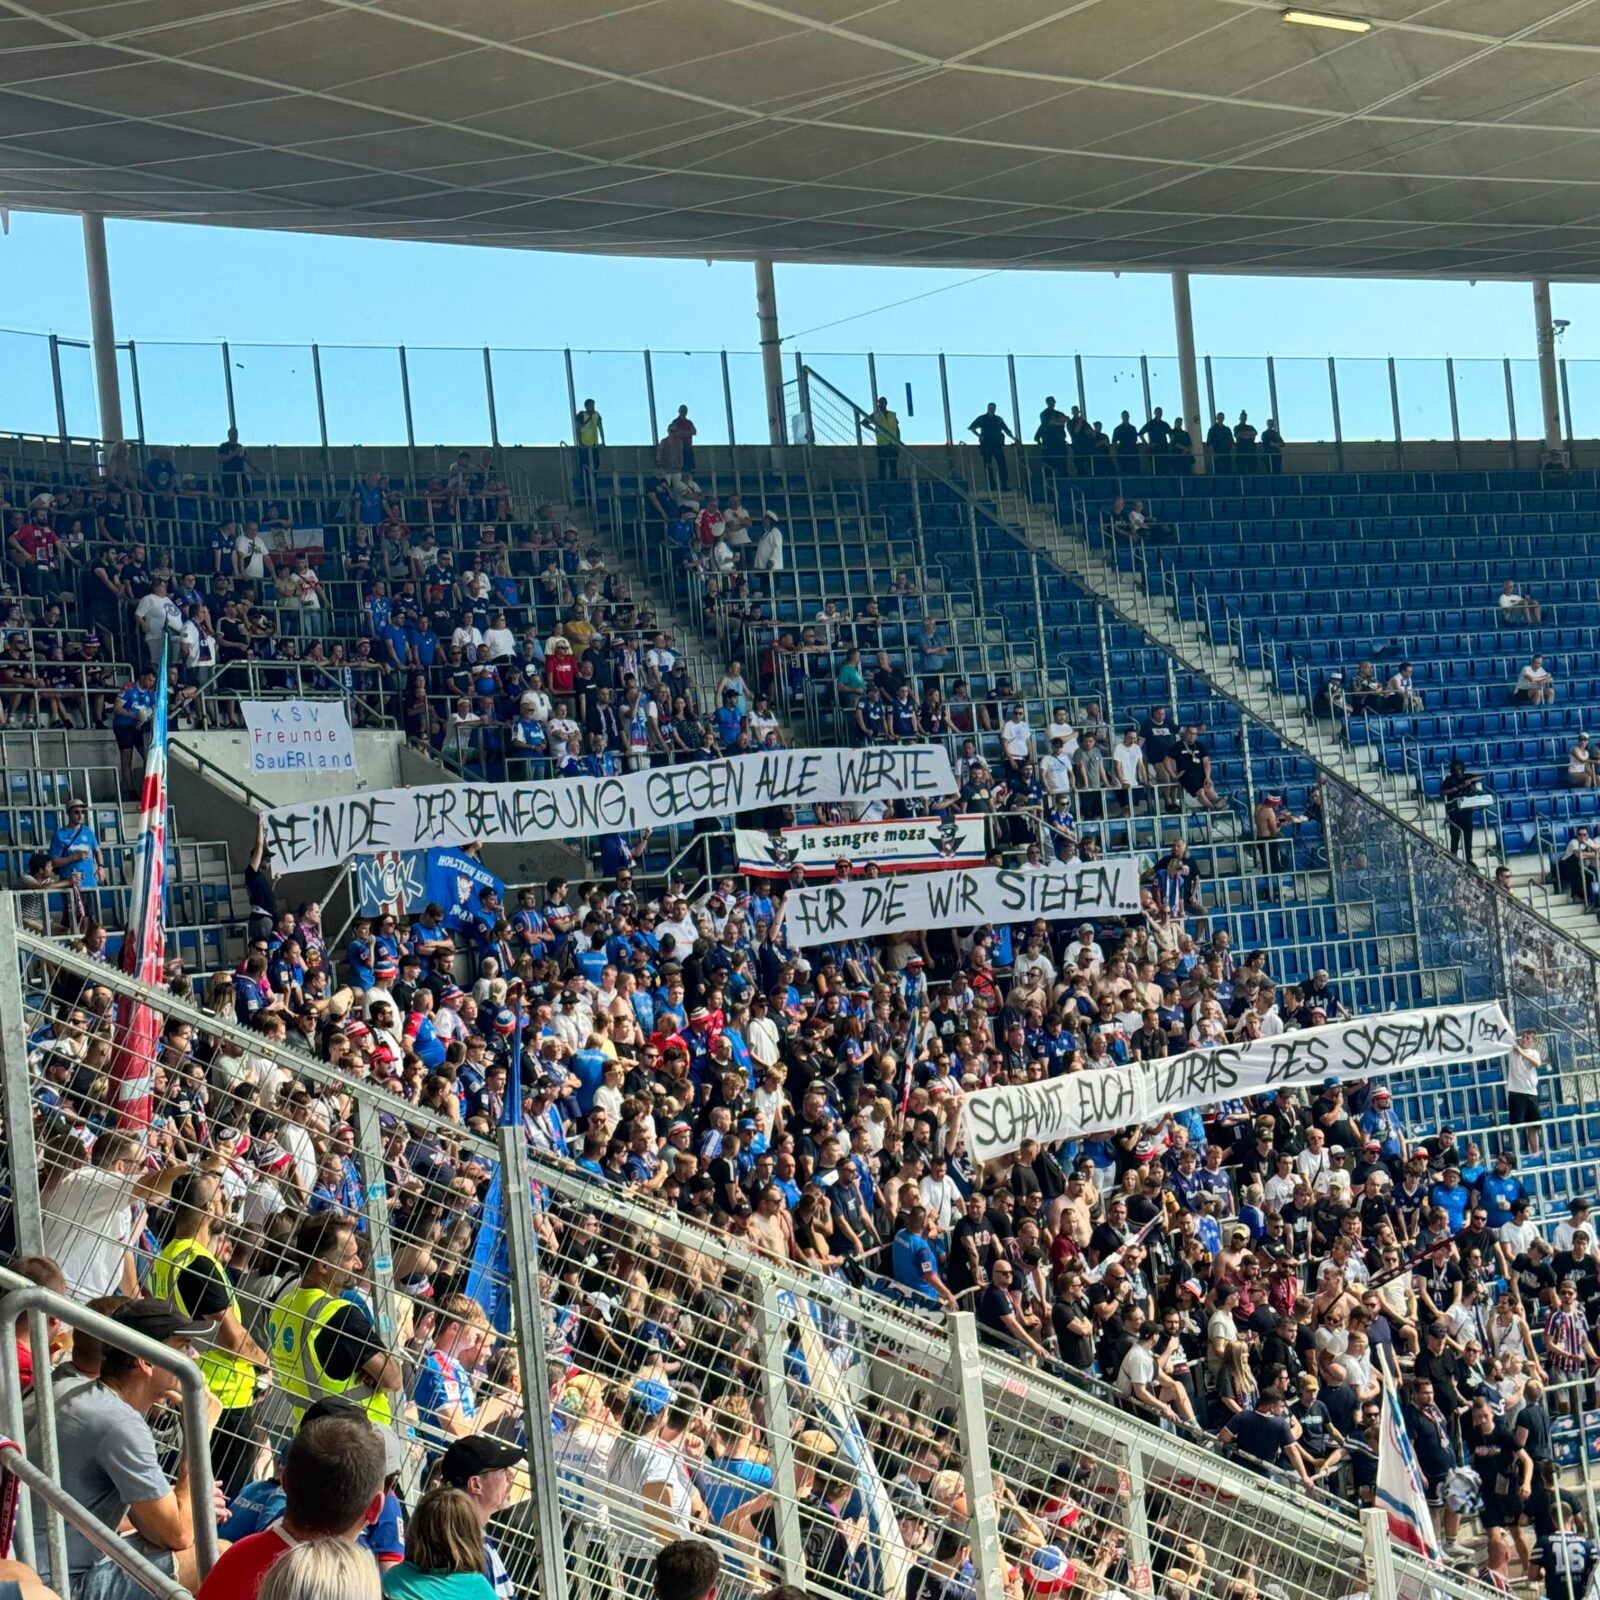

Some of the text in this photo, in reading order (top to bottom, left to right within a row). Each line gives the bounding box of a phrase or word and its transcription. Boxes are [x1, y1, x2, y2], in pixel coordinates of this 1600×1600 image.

[254, 728, 337, 744] Freunde
[255, 751, 353, 770] SauERland
[413, 788, 468, 843] DER
[646, 761, 744, 818] GEGEN
[755, 754, 823, 801] ALLE
[837, 749, 938, 796] WERTE
[800, 828, 926, 850] la sangre moza
[437, 854, 495, 887] HOLSTEIN KIEL
[795, 886, 848, 936] FÜR
[968, 1083, 1064, 1145] SCHÄMT
[1077, 1066, 1134, 1128] EUCH
[1265, 1036, 1329, 1084] DES
[1341, 1011, 1477, 1070] SYSTEMS!
[1551, 1542, 1586, 1575] 16
